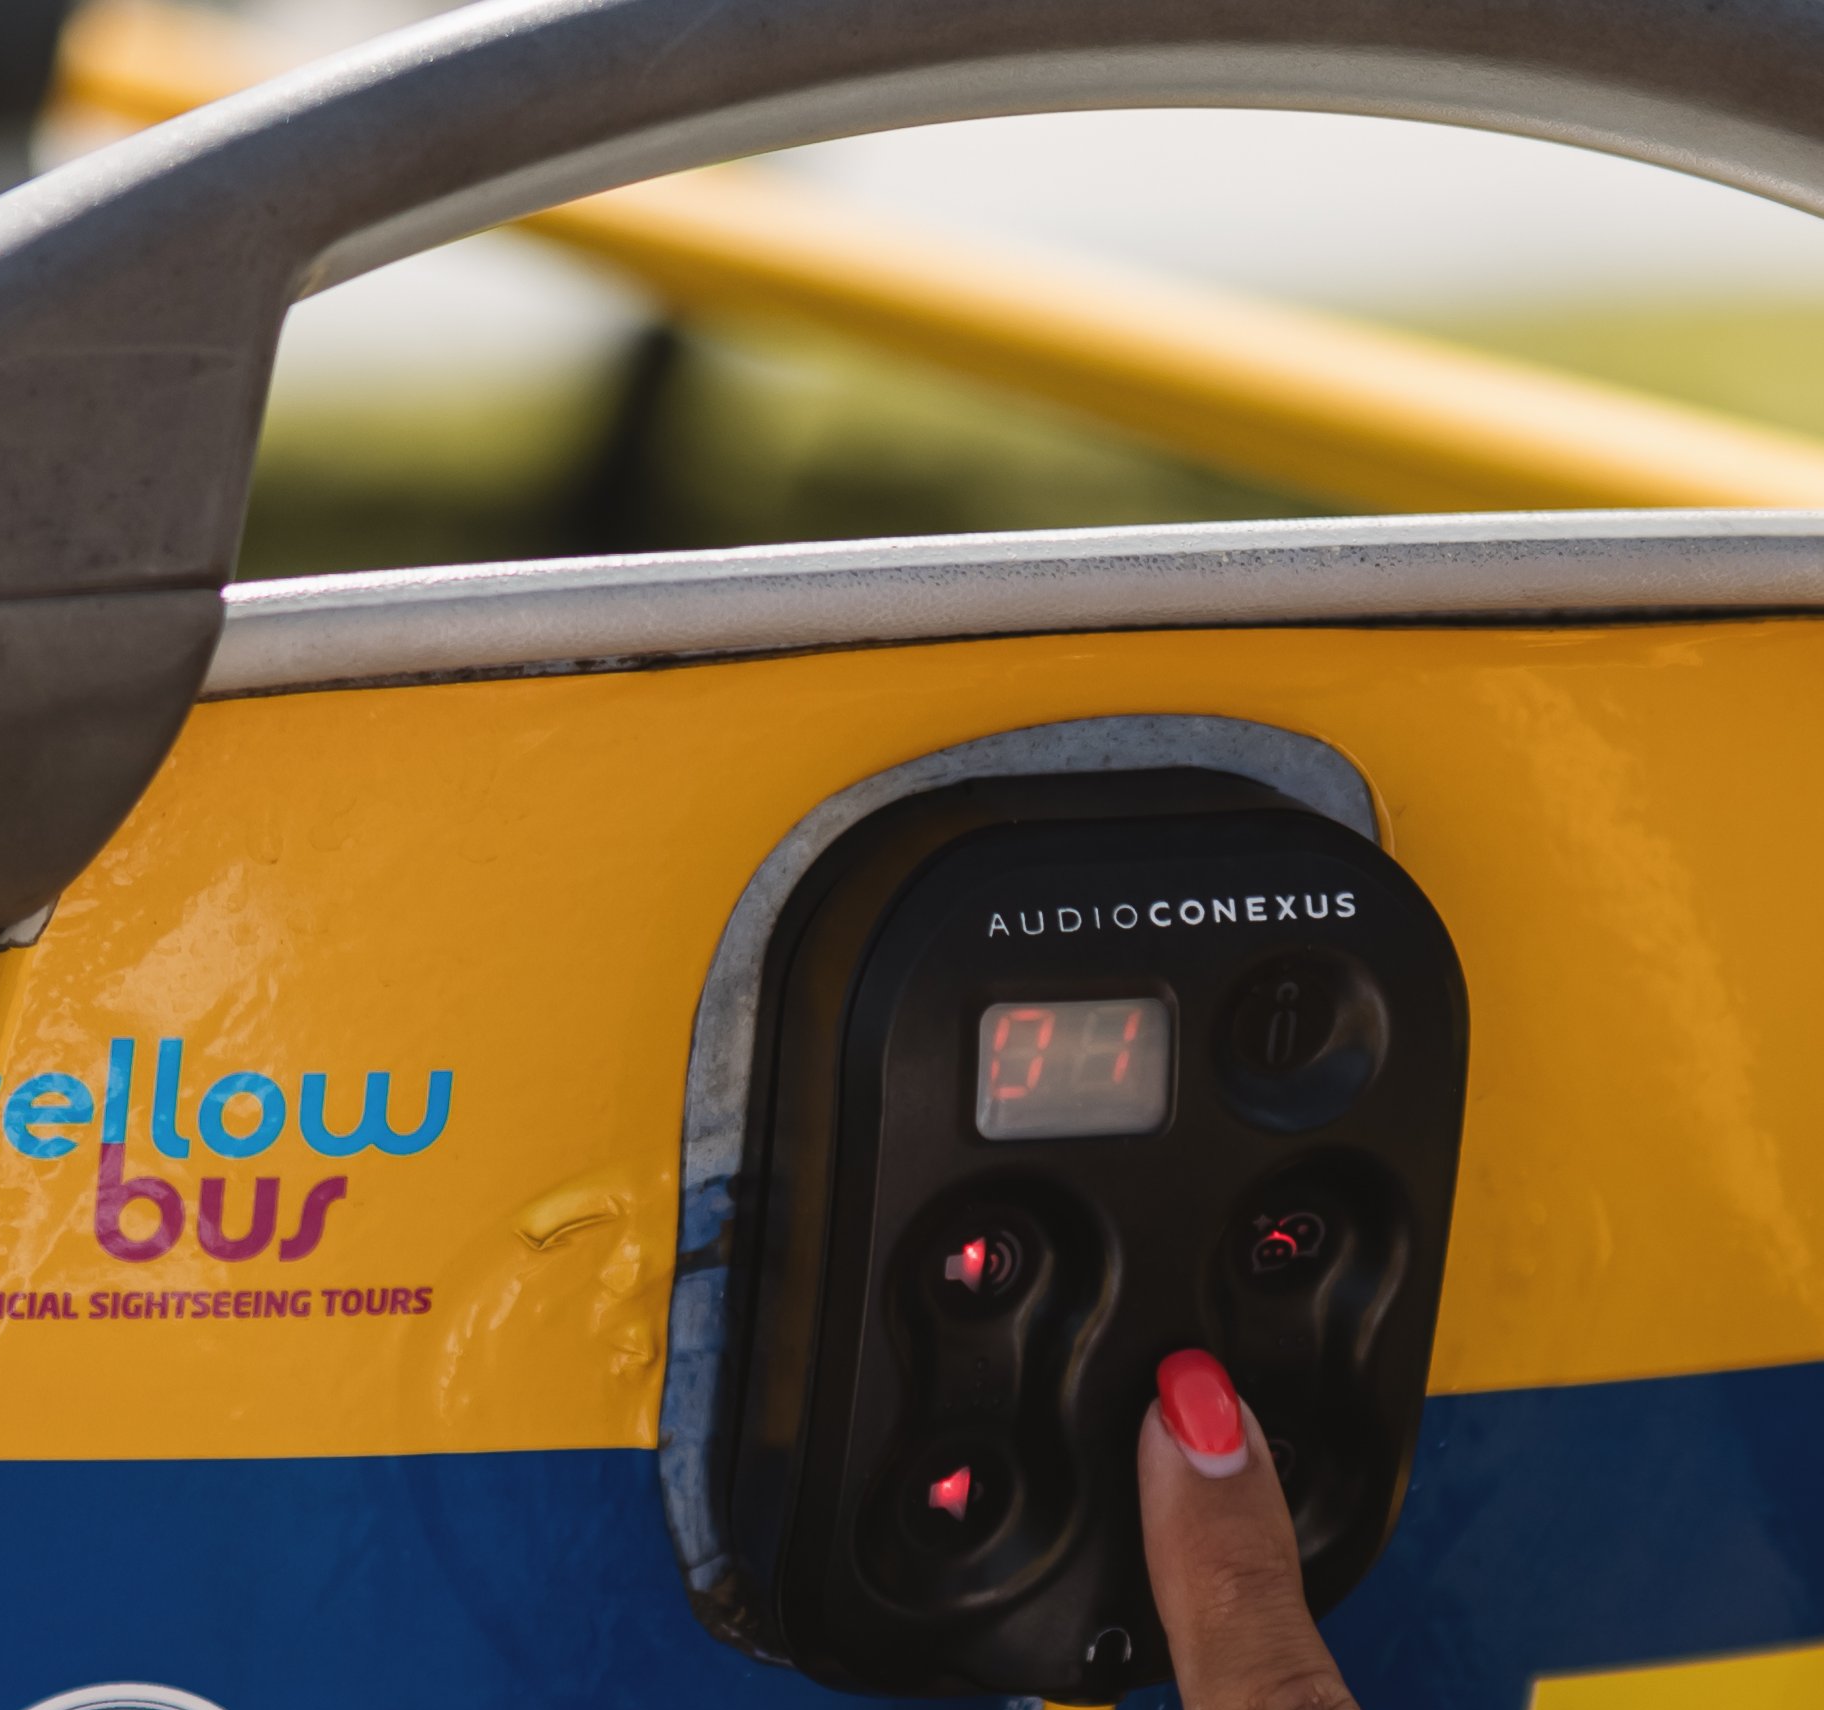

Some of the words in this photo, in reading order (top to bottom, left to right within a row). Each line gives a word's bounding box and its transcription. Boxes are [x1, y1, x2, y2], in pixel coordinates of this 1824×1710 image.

[989, 891, 1357, 938] AUDIOCONEXUS
[989, 1007, 1143, 1099] 01
[94, 1142, 348, 1263] bus
[87, 1288, 312, 1319] SIGHTSEEING
[321, 1286, 434, 1317] TOURS
